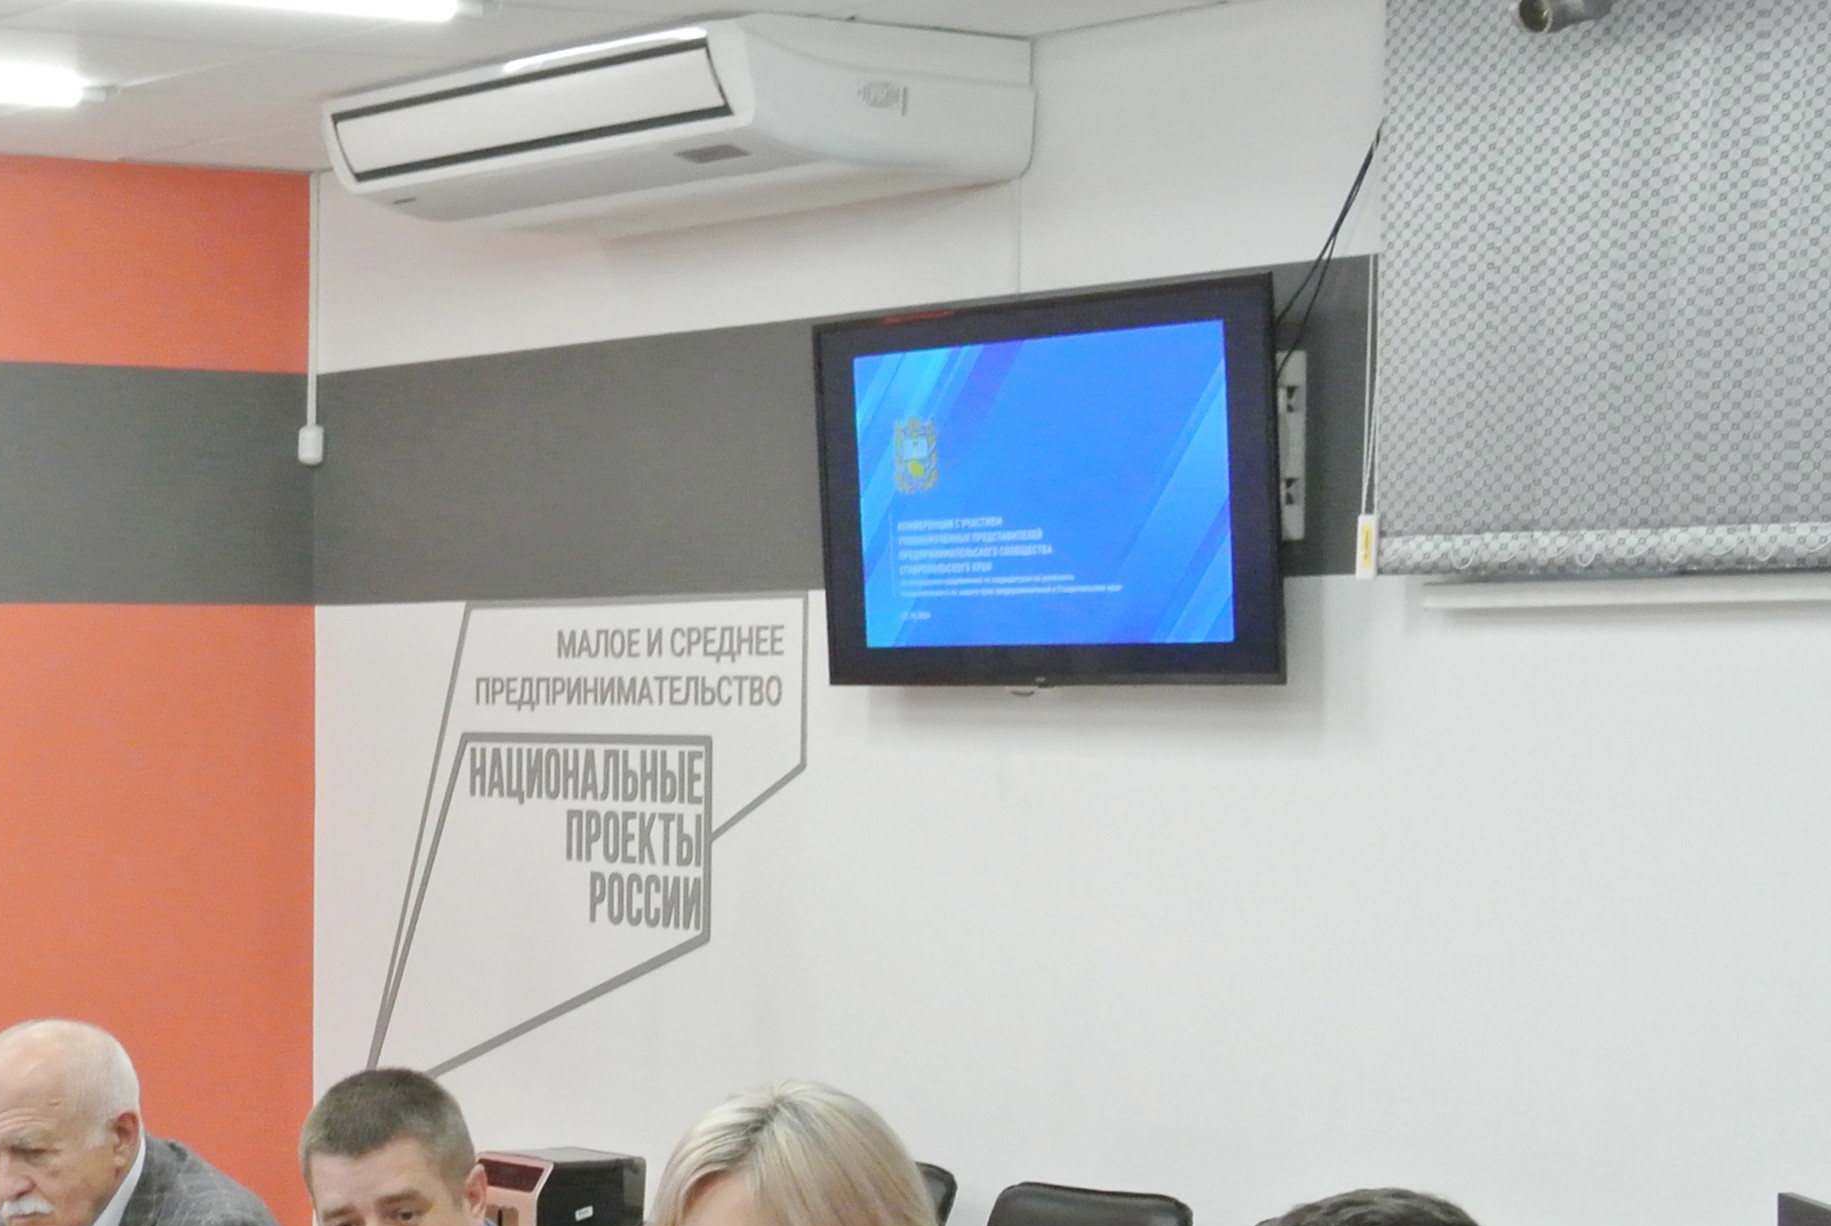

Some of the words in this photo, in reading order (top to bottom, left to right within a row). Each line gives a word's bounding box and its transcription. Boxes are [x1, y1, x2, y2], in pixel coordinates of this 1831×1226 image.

[556, 628, 642, 660] МАЛОЕ
[646, 627, 664, 658] И
[669, 624, 785, 664] СРЕДНЕЕ
[474, 674, 784, 711] ПРЕДПРИНИМАТЕЛЬСТВО
[469, 746, 704, 805] НАЦИОНАЛЬНЫЕ
[565, 808, 703, 869] ПРОЕКТЫ
[588, 870, 702, 932] РОССИИ
